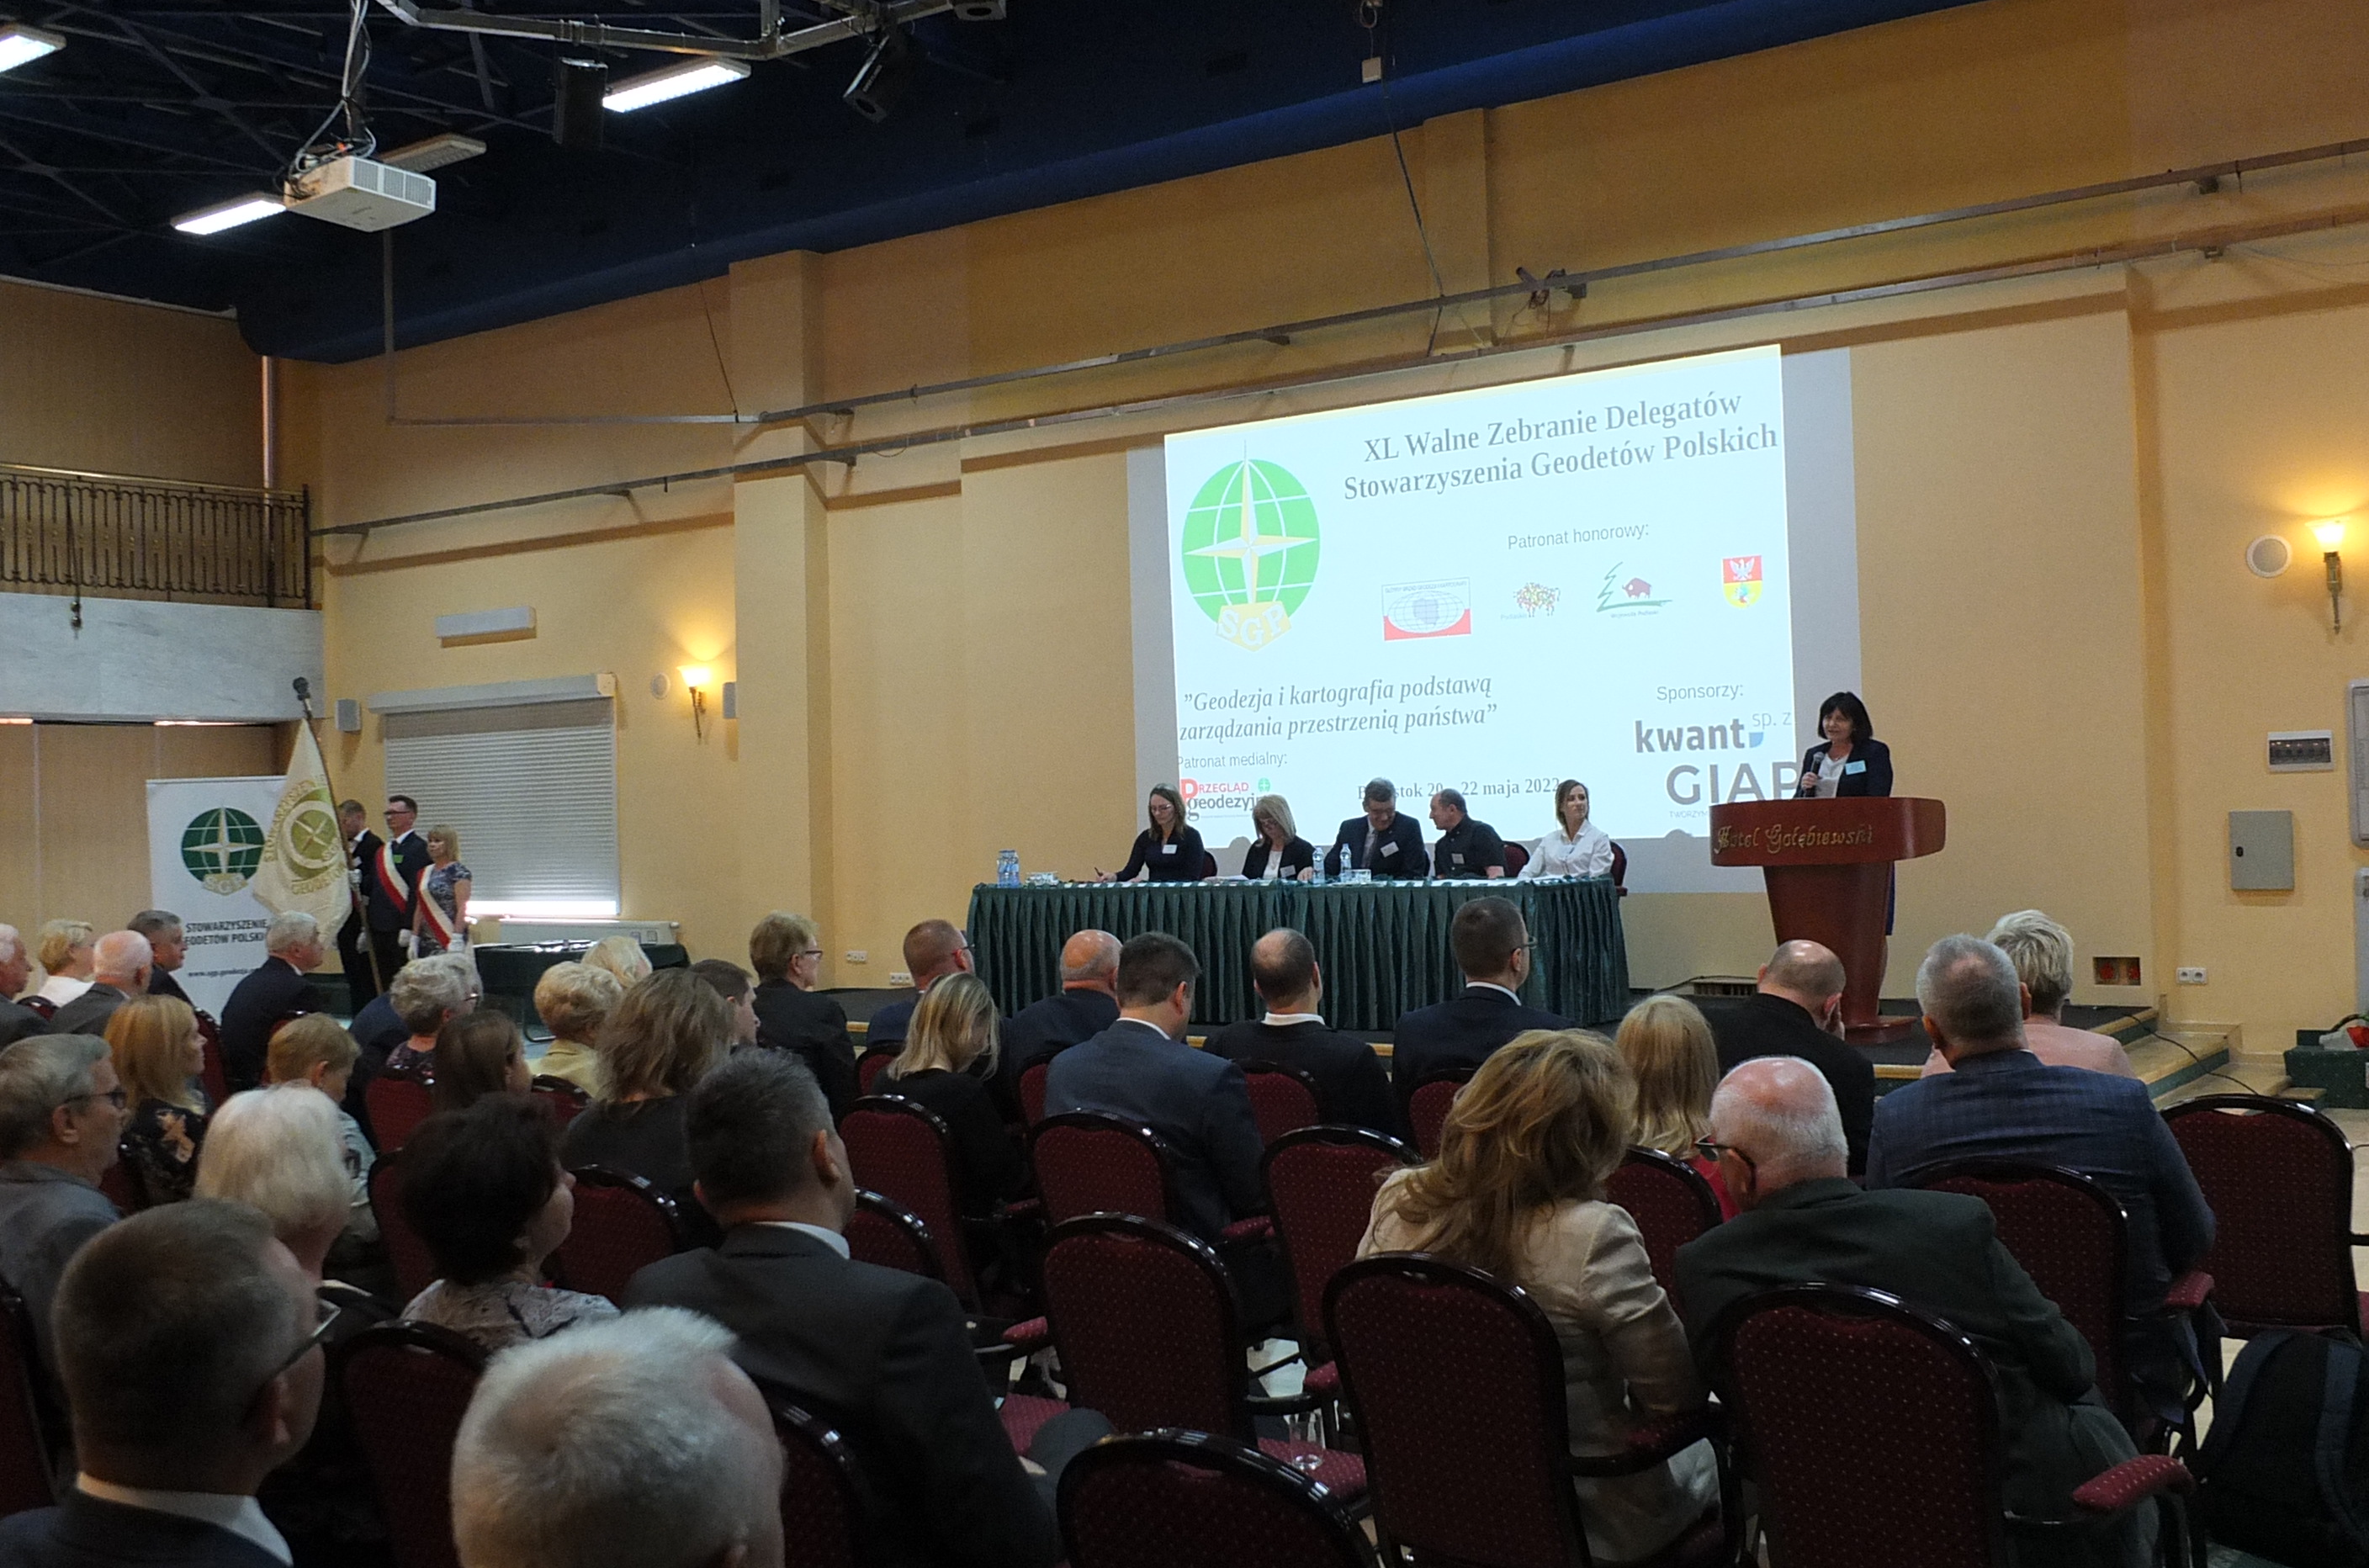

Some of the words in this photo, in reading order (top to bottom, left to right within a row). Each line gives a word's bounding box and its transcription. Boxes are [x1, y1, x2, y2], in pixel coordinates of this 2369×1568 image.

[1364, 437, 1400, 463] XL
[1404, 427, 1480, 457] Walne
[1487, 410, 1598, 447] Zebranie
[1604, 390, 1741, 430] Delegatów
[1344, 456, 1523, 501] Stowarzyszenia
[1531, 439, 1656, 477] Geodetów
[1662, 422, 1778, 460] Polskich
[1508, 529, 1569, 550] Patronat
[1573, 523, 1649, 543] honorowy:
[1217, 603, 1285, 646] SGP
[1278, 686, 1285, 706] i
[1290, 678, 1394, 707] kartografia
[1399, 675, 1492, 704] podstawą
[1656, 684, 1744, 704] Sponsorzy:
[1179, 715, 1282, 744] zarządzania
[1287, 708, 1398, 740] przestrzenią
[1403, 702, 1497, 734] państwa”
[1635, 718, 1746, 754] kwant
[1752, 712, 1777, 730] sp.
[1178, 755, 1226, 769] Patronat
[1229, 751, 1288, 768] medialny:
[1460, 781, 1478, 796] 22
[1482, 779, 1519, 798] maja
[1524, 777, 1560, 793] 2022
[1666, 760, 1798, 805] GIAP
[1187, 792, 1258, 822] geodezyj
[186, 918, 268, 933] STOWARZYSZENIE
[231, 931, 265, 943] POLSKI
